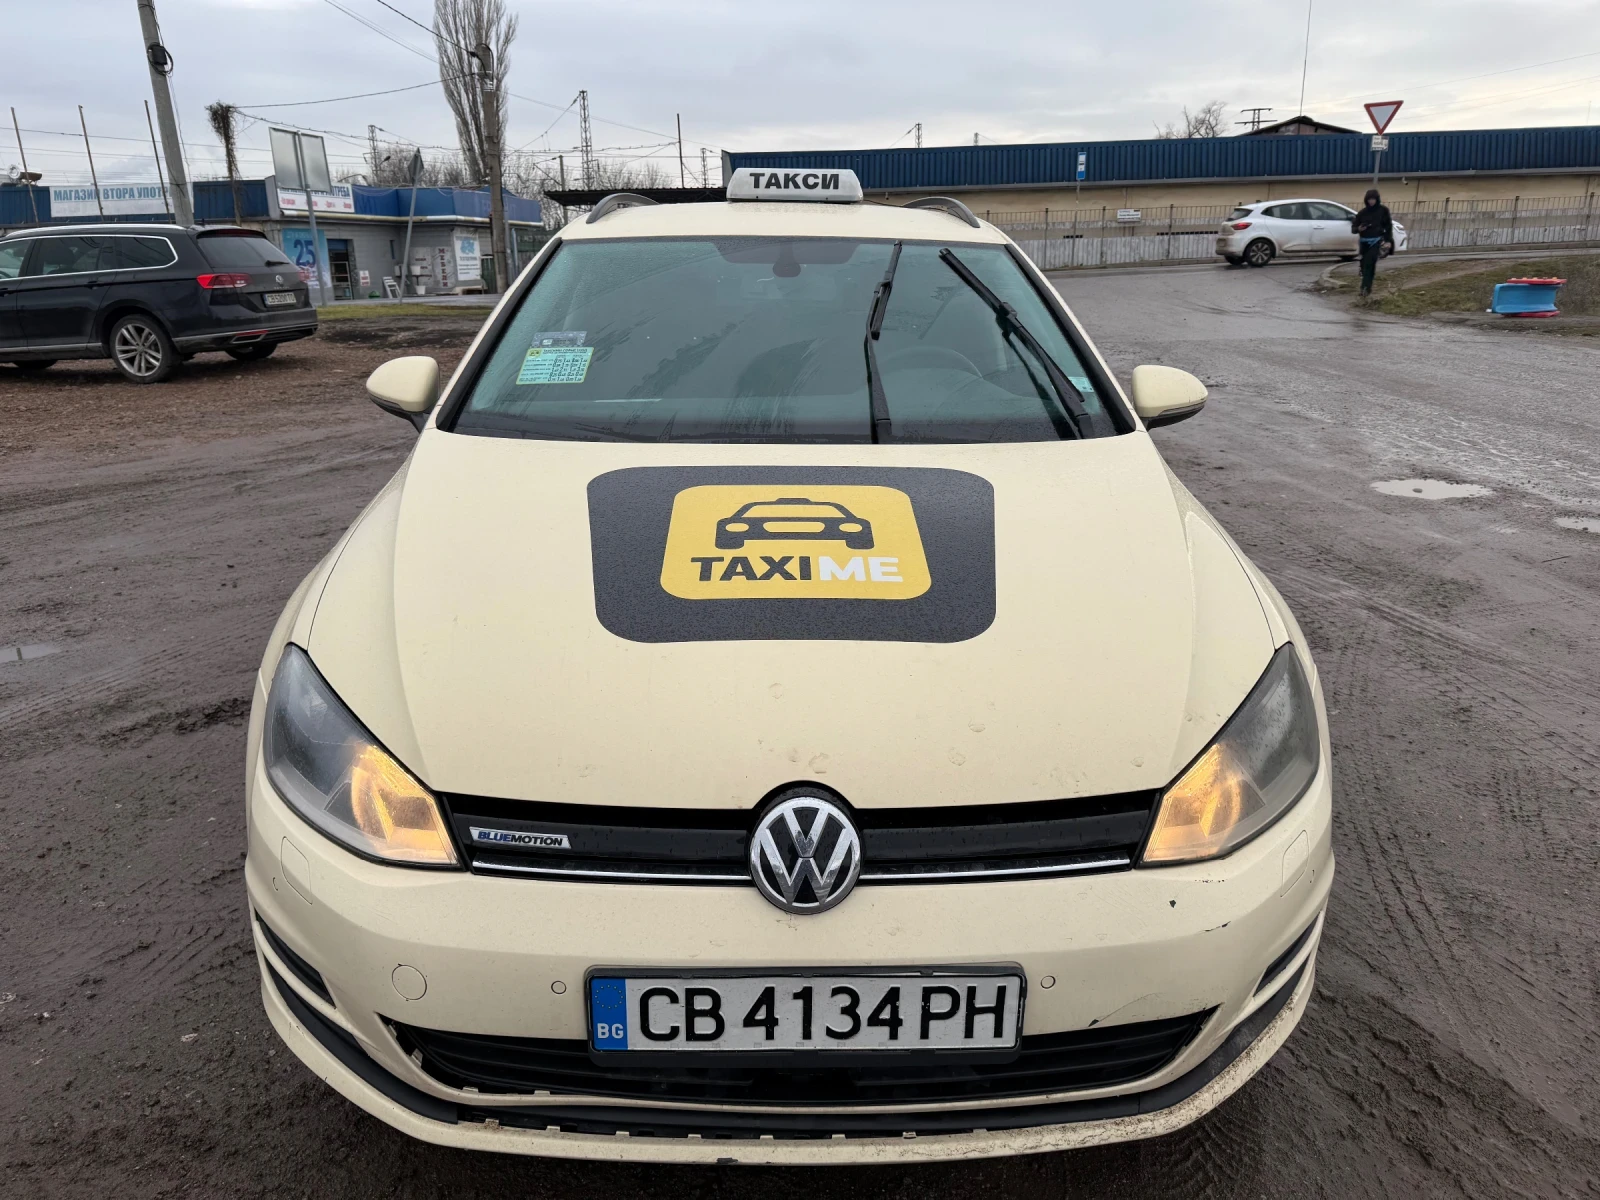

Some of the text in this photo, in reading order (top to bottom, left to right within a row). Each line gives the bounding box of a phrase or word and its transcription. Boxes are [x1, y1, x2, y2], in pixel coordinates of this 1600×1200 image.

[749, 172, 840, 190] ТАКСИ
[103, 186, 135, 200] ВТОРА
[293, 239, 316, 268] 25
[477, 830, 563, 846] BLUEMOTION
[597, 1022, 624, 1040] BG
[742, 985, 904, 1041] 4134
